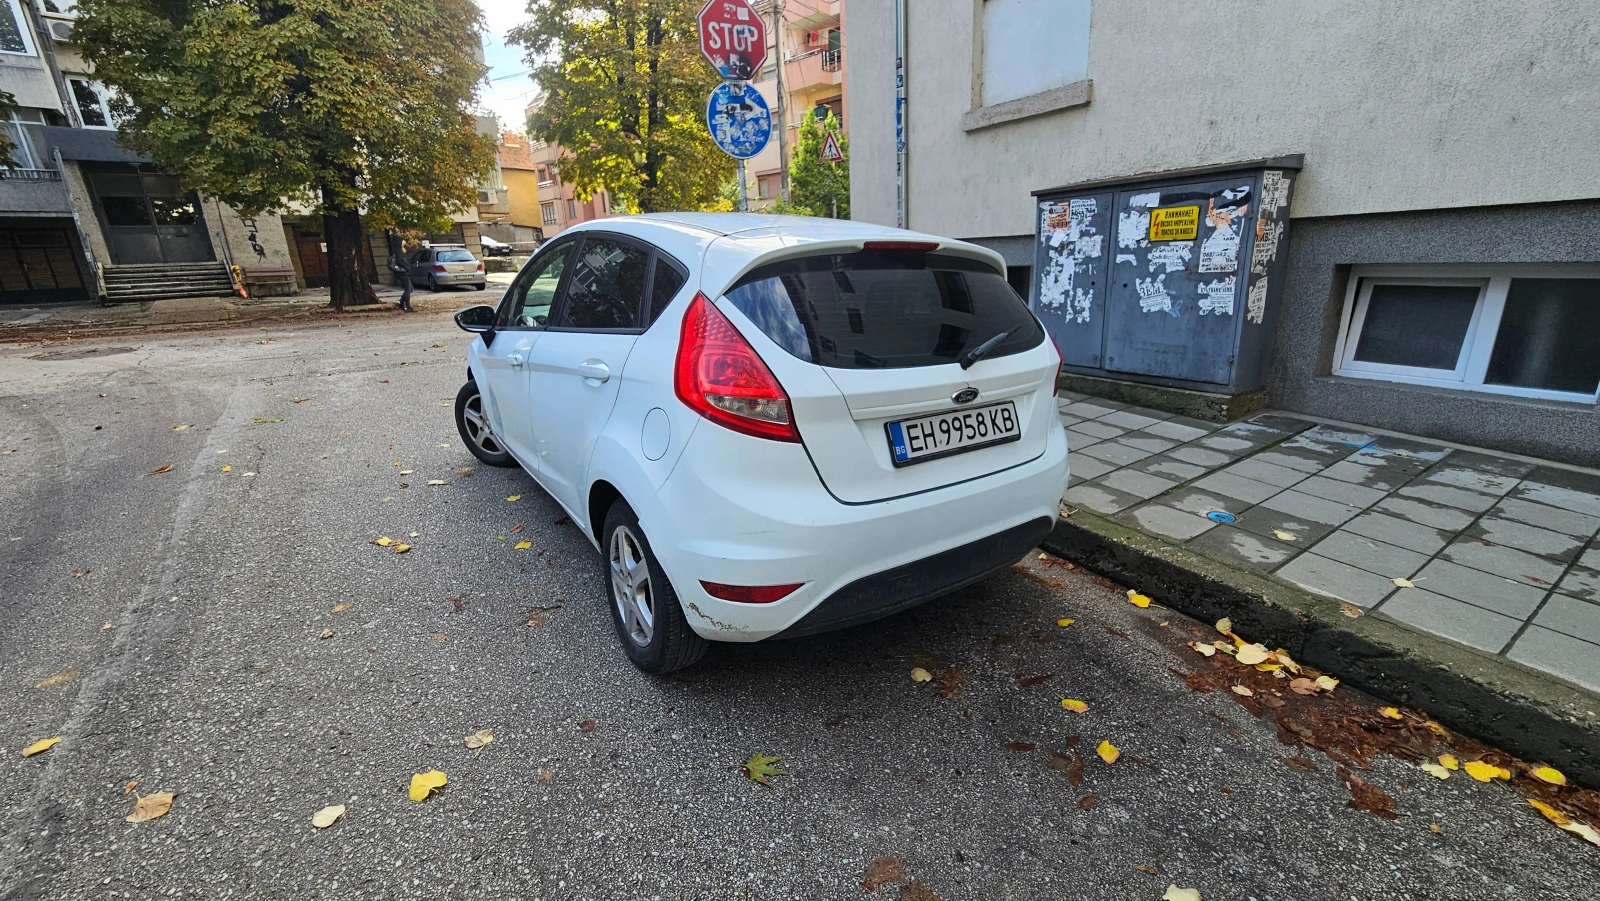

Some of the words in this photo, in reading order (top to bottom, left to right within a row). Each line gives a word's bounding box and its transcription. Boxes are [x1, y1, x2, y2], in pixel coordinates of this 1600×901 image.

[708, 21, 758, 52] STOP
[1164, 209, 1194, 219] ВНИМАНИЕ!
[958, 391, 975, 402] Ford
[906, 421, 938, 453] EH
[938, 412, 988, 446] 9958
[989, 408, 1015, 436] KB
[895, 445, 906, 455] BG
